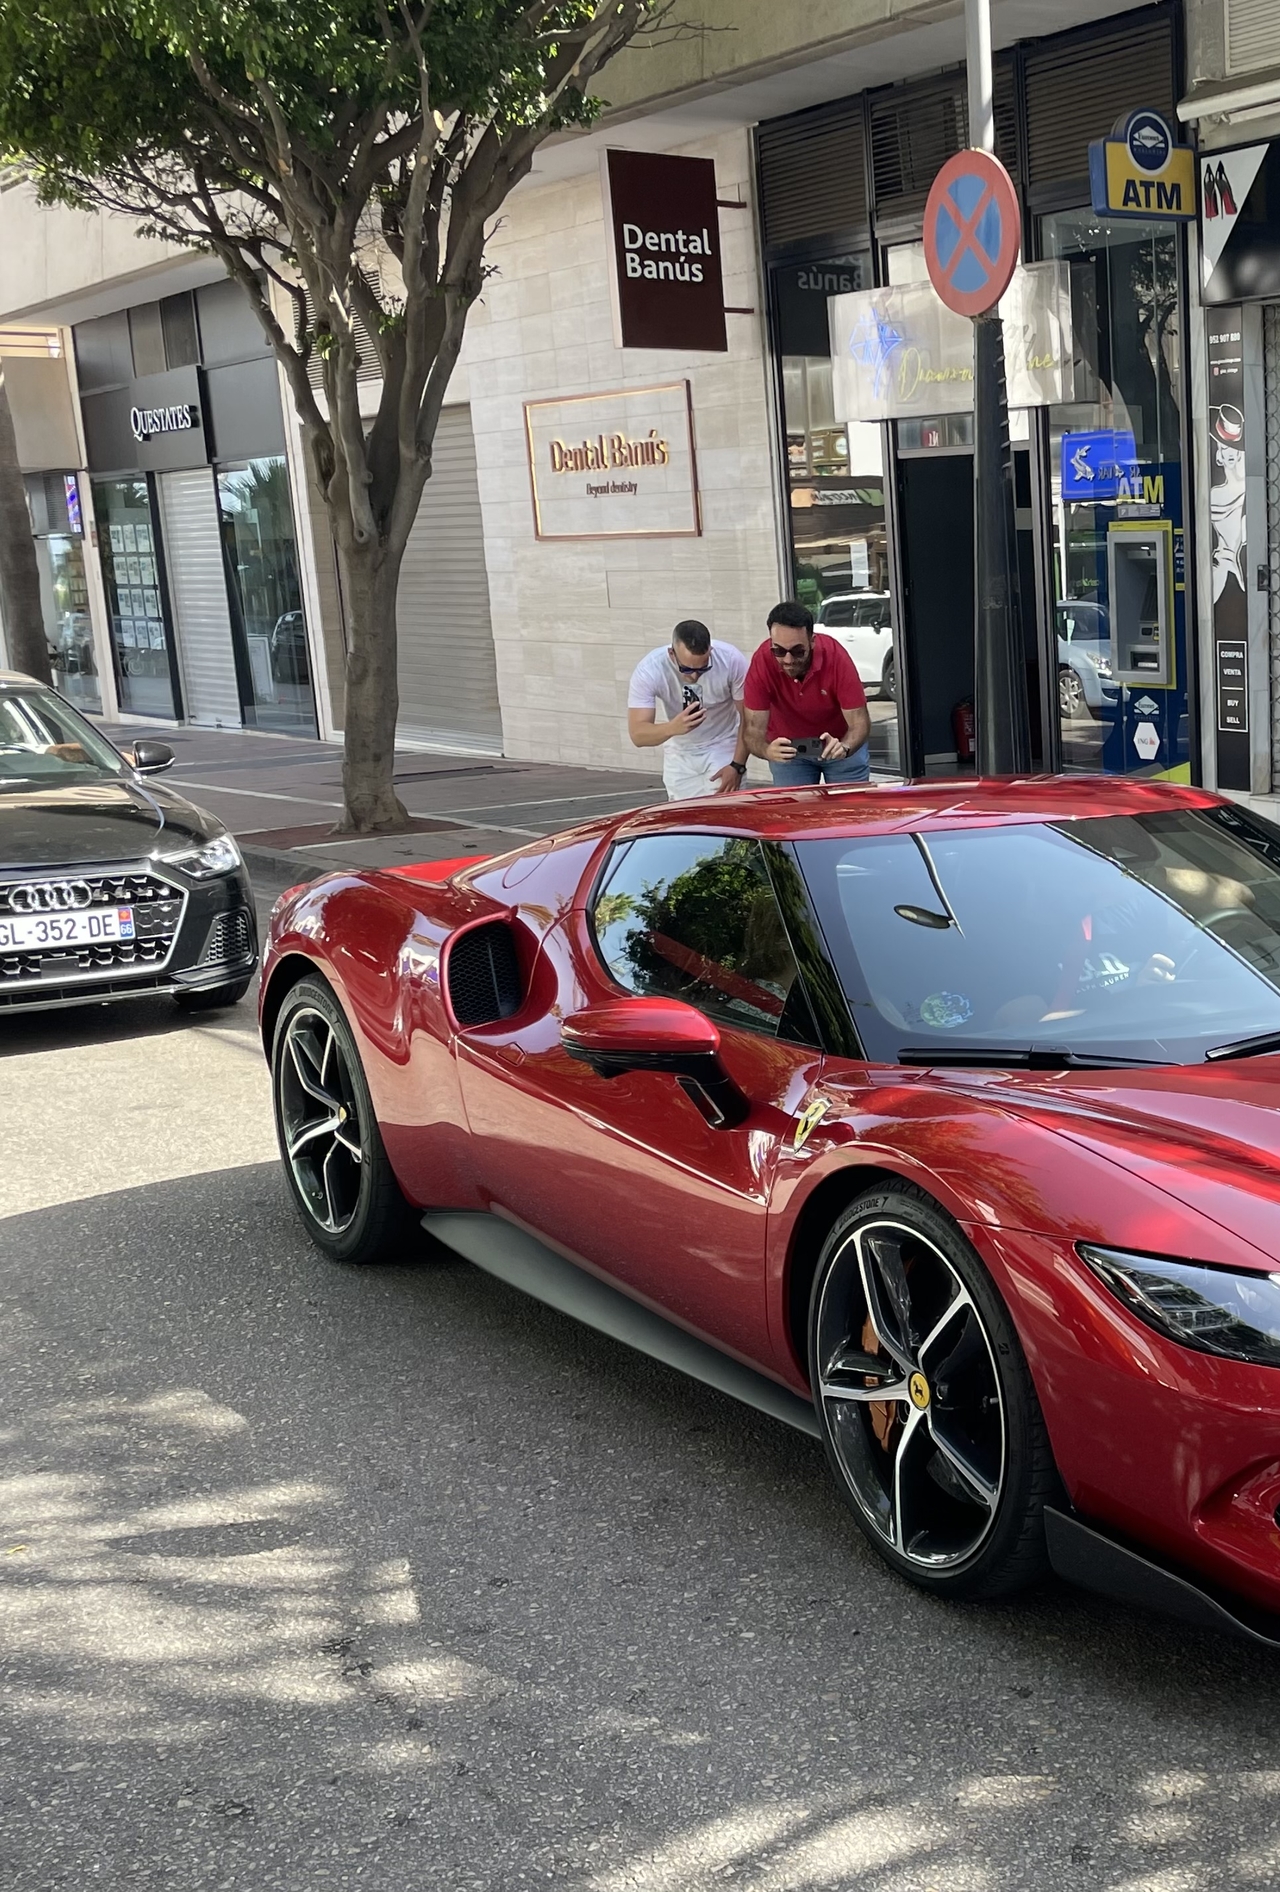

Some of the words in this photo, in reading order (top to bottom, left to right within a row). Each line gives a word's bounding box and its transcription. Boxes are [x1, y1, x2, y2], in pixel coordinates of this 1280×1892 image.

[1122, 178, 1182, 211] ATM
[623, 223, 712, 255] Dental
[625, 255, 704, 283] Banús
[130, 404, 192, 442] QUESTATES
[550, 434, 608, 473] Dental
[609, 429, 669, 468] Banús
[586, 481, 610, 498] Beyond
[610, 480, 638, 496] dentistry
[1117, 475, 1164, 504] ATM
[1220, 650, 1244, 659] COMPRA
[1223, 668, 1242, 676] VENTA
[1226, 699, 1240, 707] BUY
[1226, 716, 1240, 724] SELL
[1137, 737, 1149, 746] ING
[120, 923, 132, 935] 66
[1099, 972, 1129, 988] LAUREN
